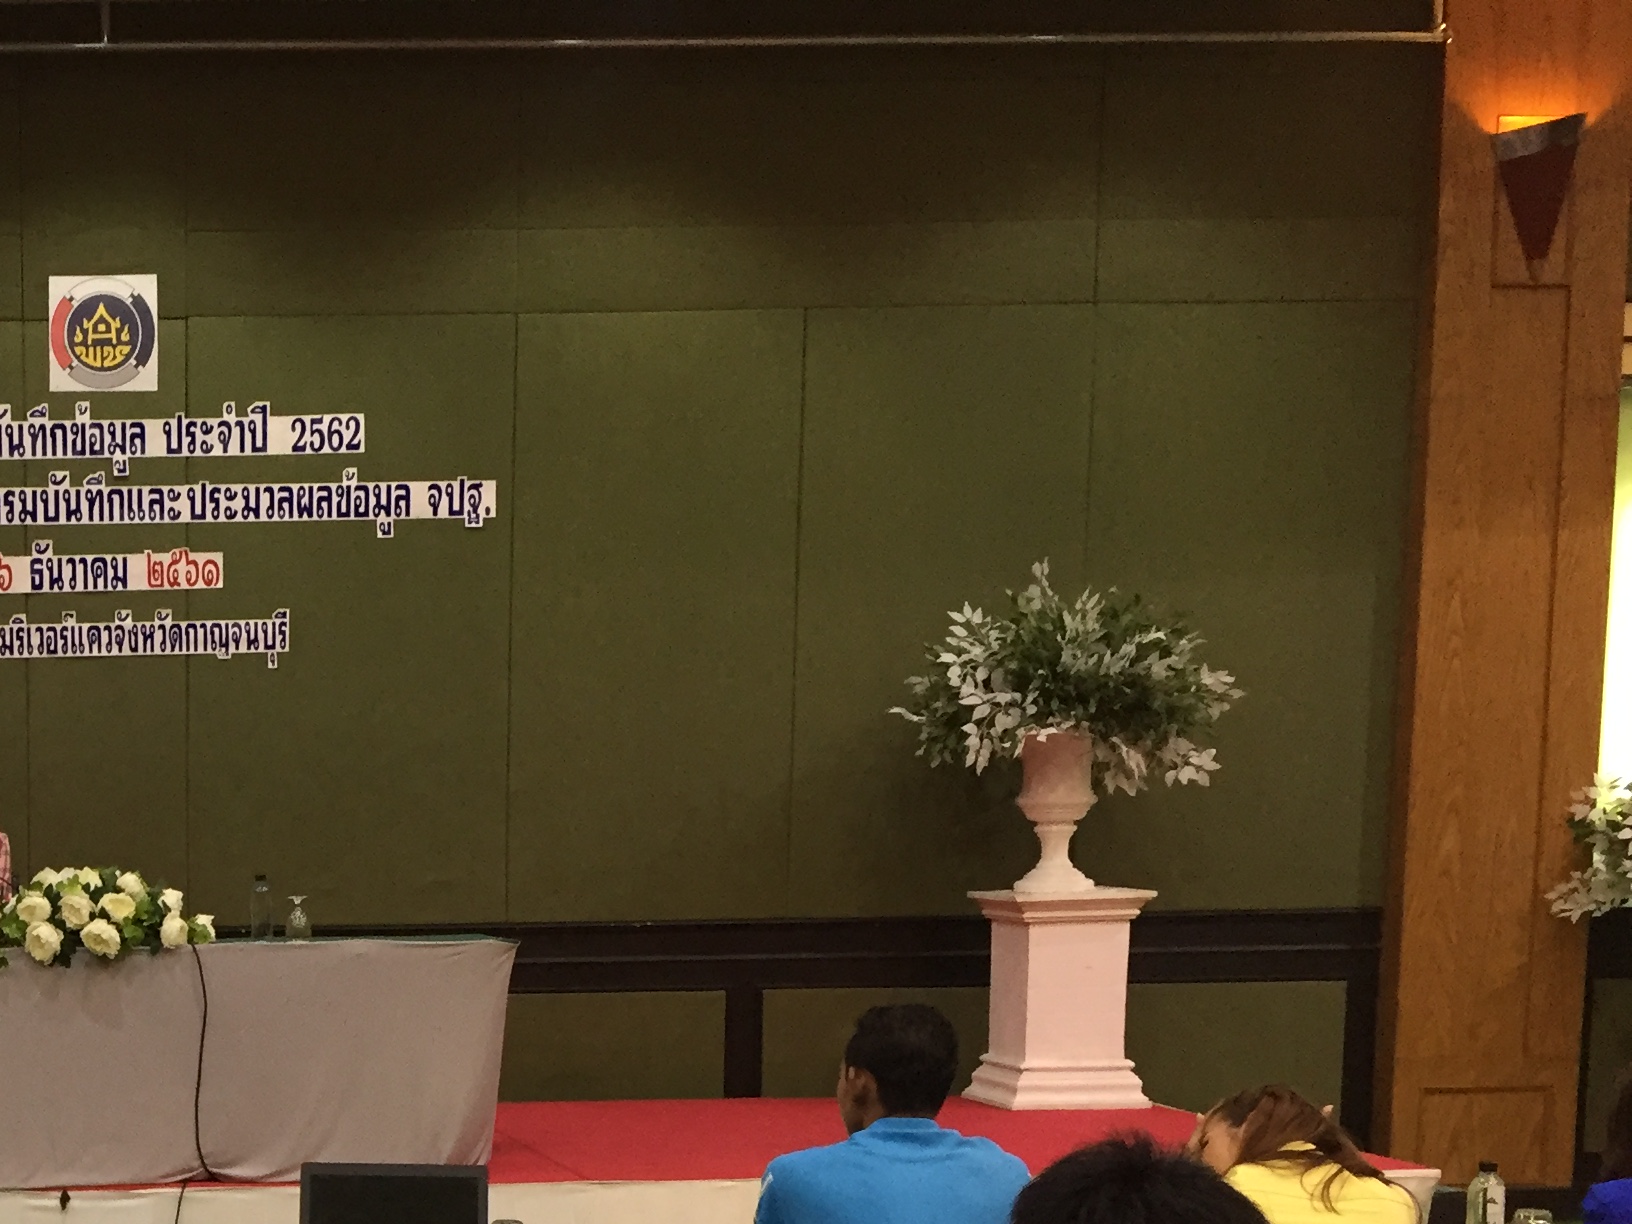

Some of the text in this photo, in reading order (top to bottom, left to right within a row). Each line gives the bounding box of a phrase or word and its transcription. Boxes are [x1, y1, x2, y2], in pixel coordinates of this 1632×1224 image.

[162, 402, 269, 455] ประจำปี
[290, 415, 363, 454] 2562
[426, 478, 492, 525] จปฐ.
[29, 542, 128, 591] ธันวาคม
[145, 549, 221, 589] ๒๕๖๑
